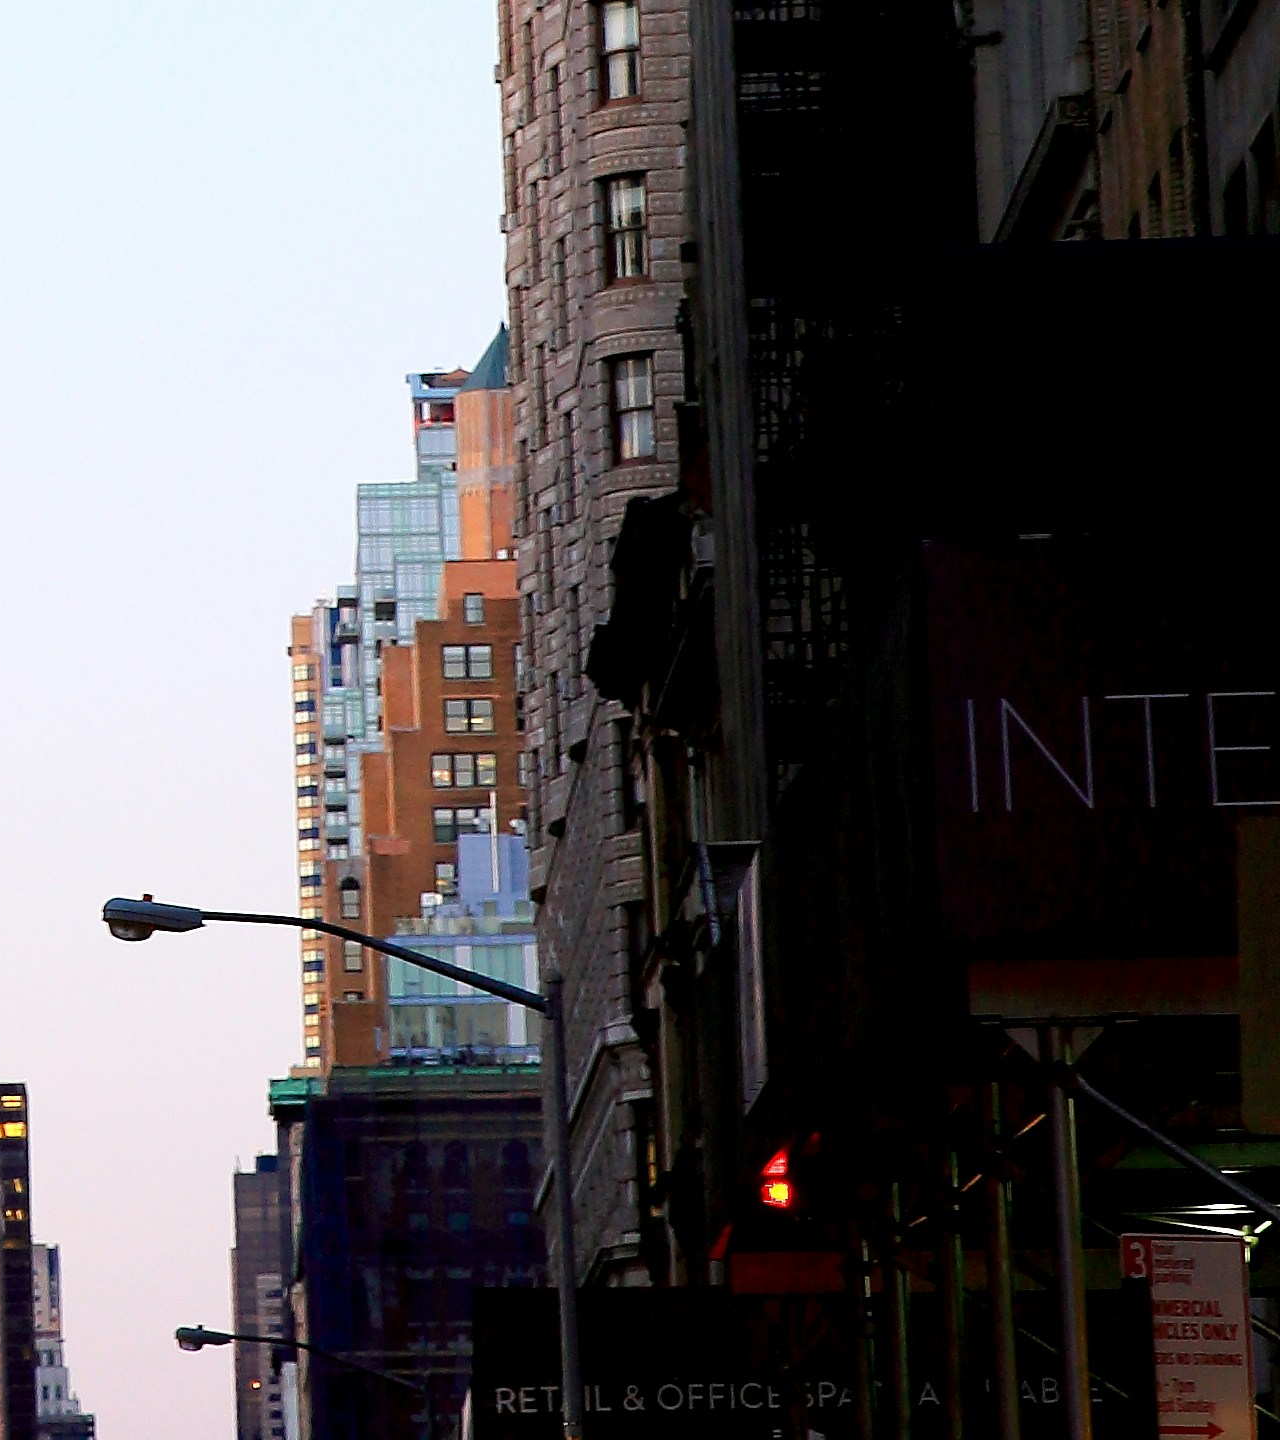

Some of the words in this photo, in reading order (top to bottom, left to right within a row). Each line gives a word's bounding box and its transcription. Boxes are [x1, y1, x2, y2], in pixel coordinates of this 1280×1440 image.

[966, 691, 1280, 813] INTE
[495, 1384, 613, 1414] RETIL
[657, 1382, 781, 1410] OFFICE
